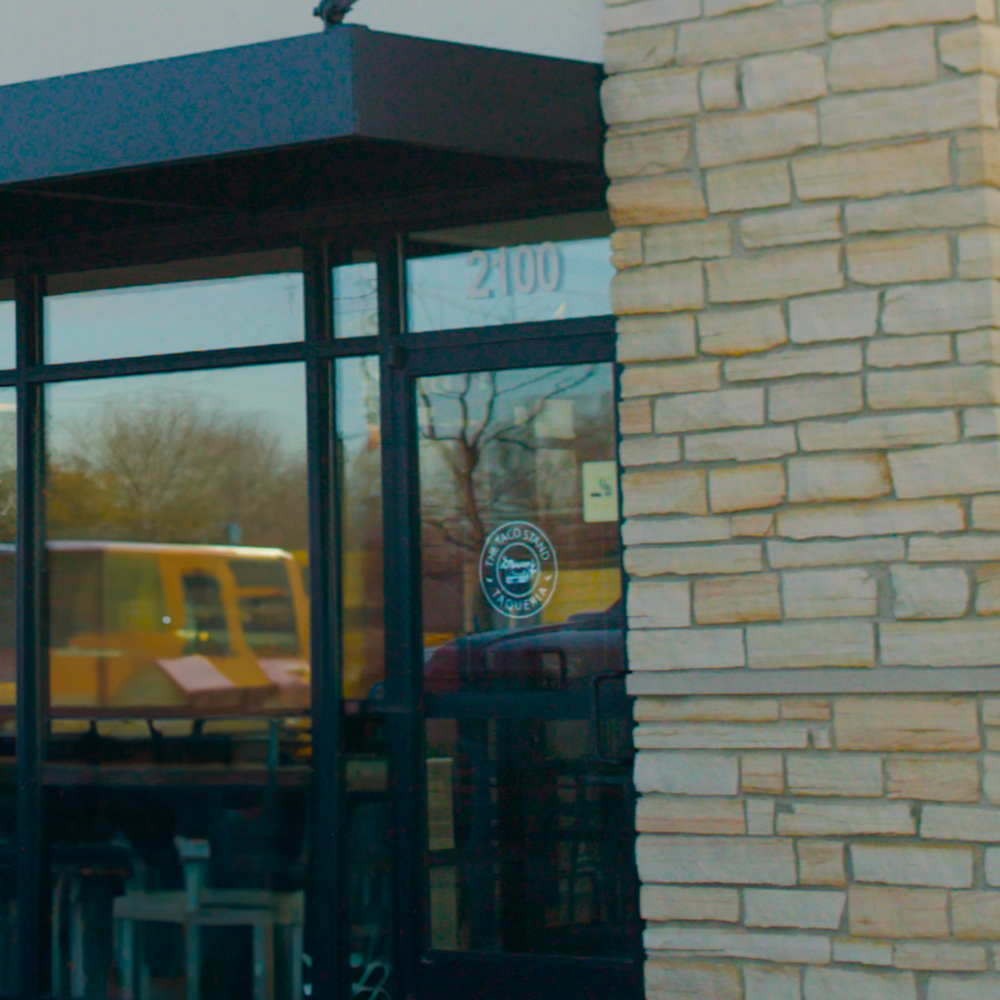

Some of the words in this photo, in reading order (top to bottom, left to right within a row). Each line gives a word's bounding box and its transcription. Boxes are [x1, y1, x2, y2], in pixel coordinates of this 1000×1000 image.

[467, 241, 562, 299] 2100
[485, 543, 499, 567] THE
[494, 527, 521, 544] TACO
[523, 529, 551, 561] STAND
